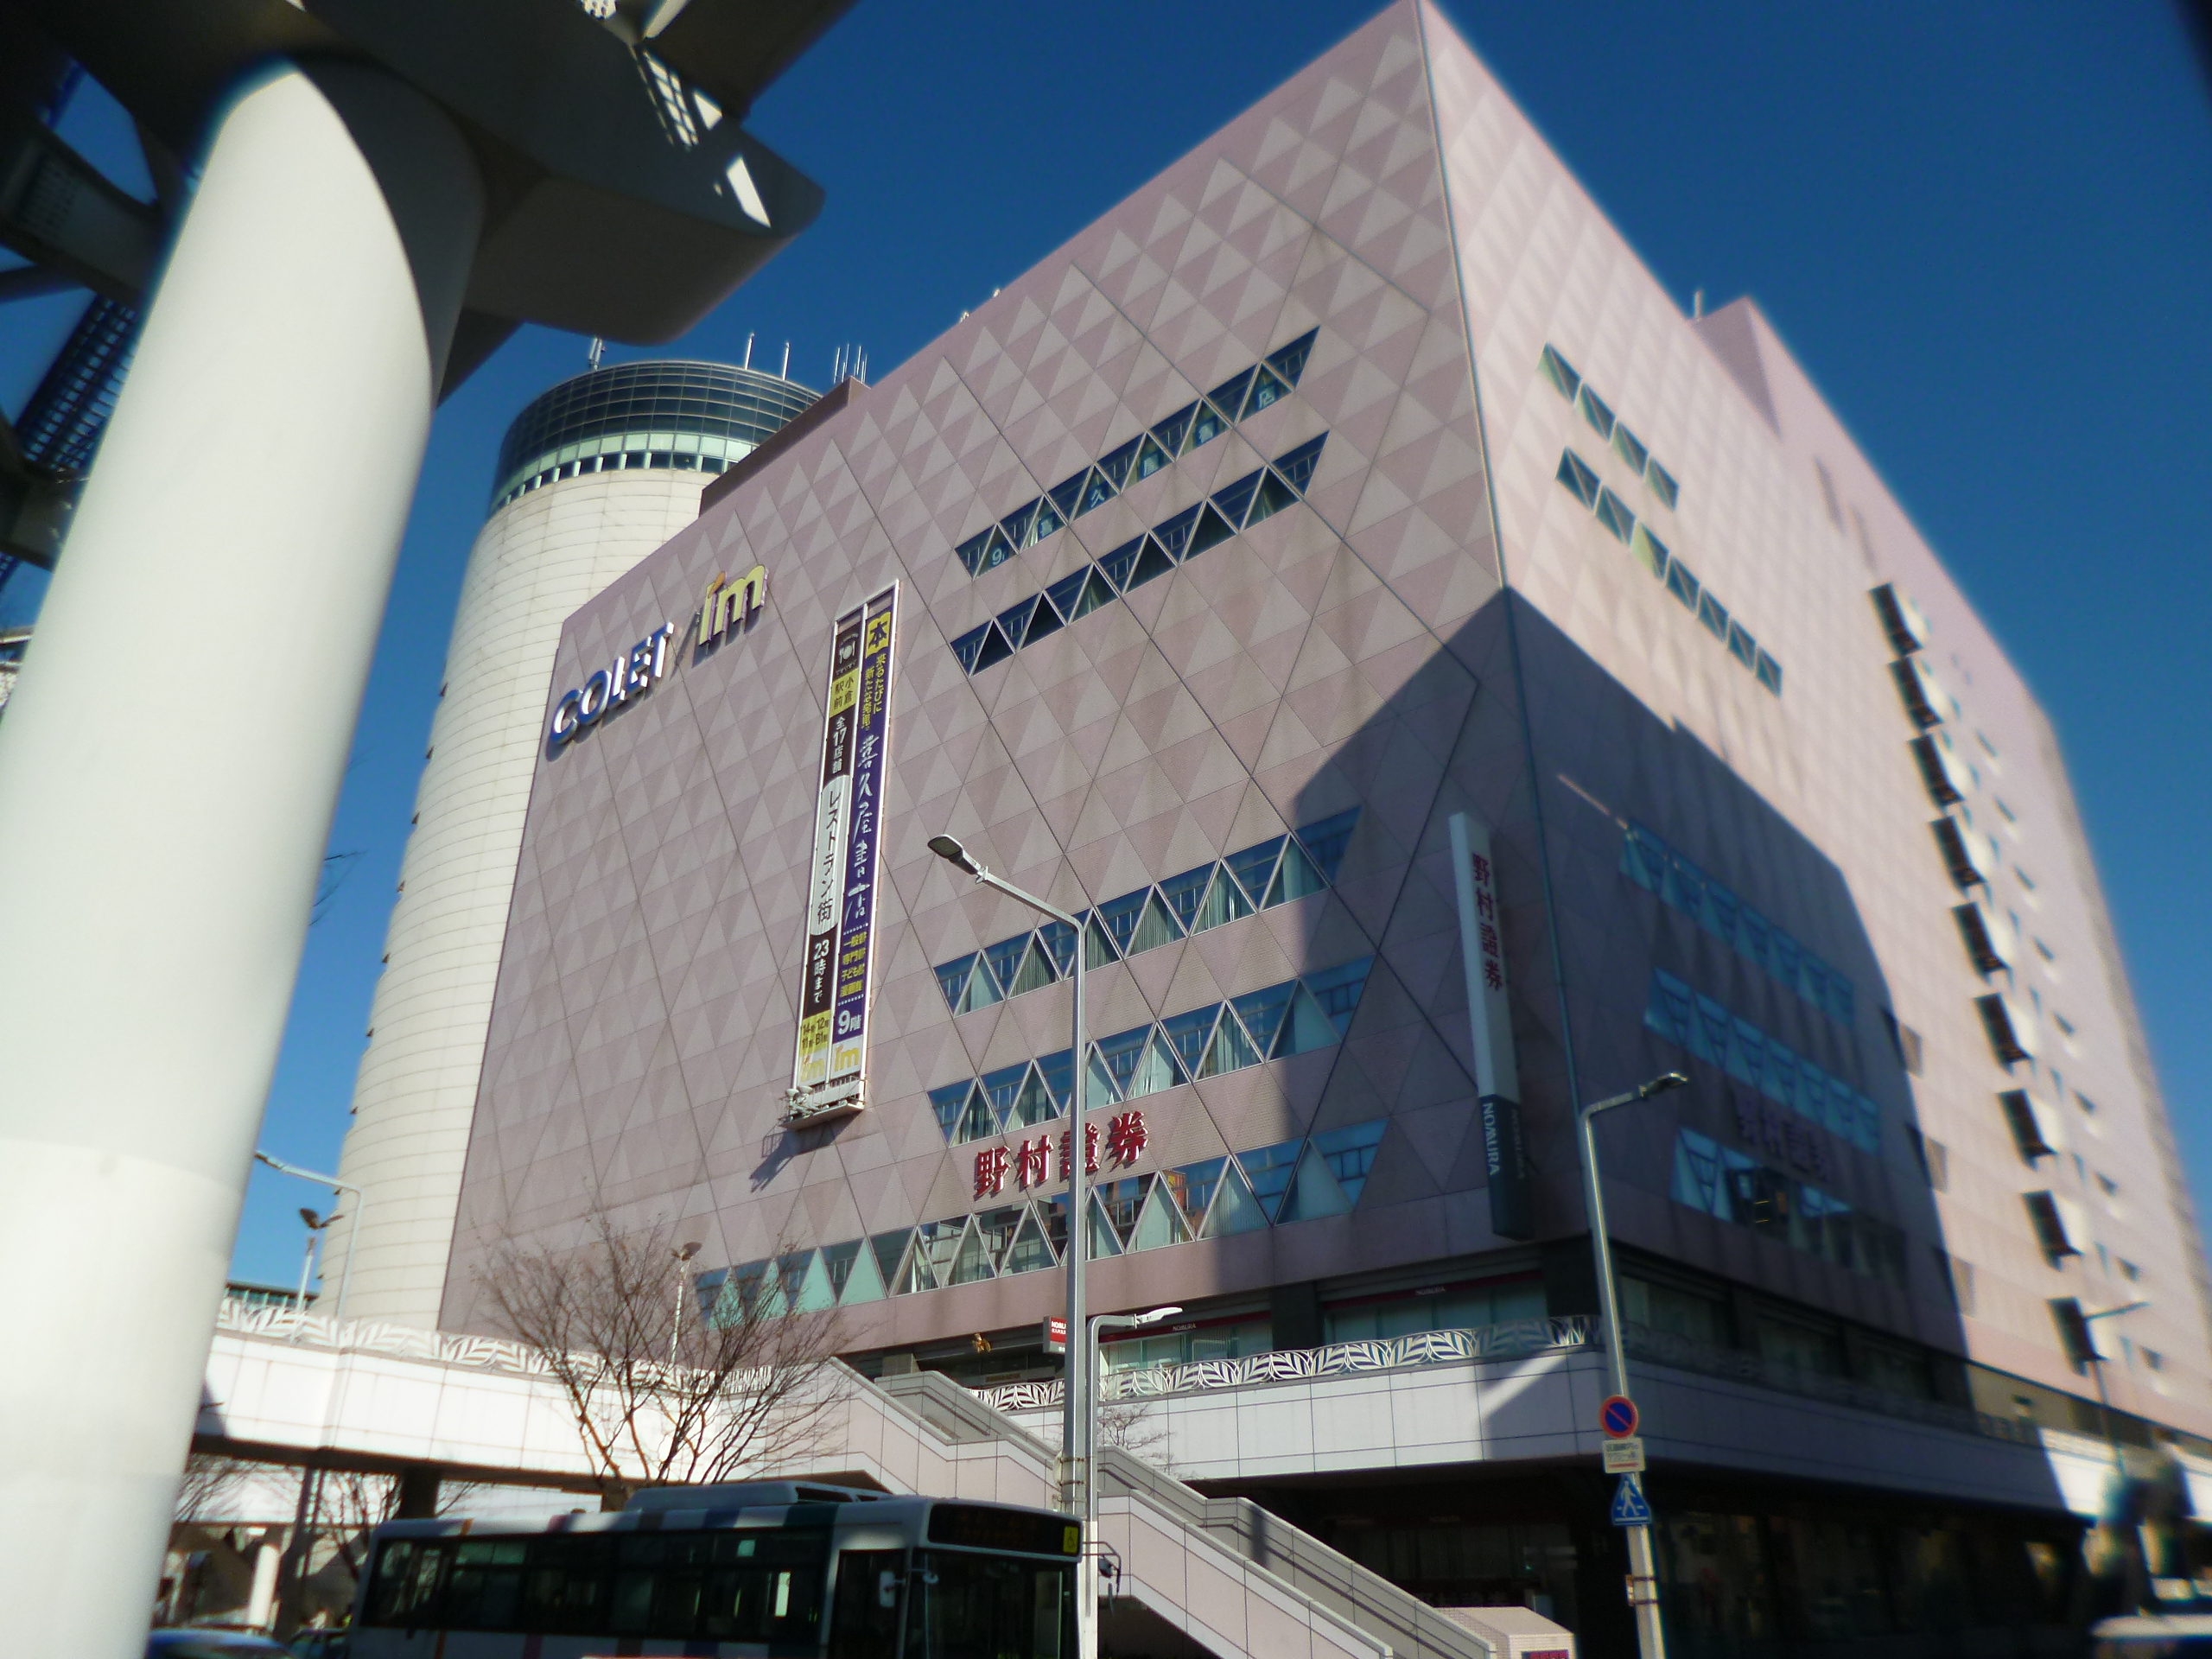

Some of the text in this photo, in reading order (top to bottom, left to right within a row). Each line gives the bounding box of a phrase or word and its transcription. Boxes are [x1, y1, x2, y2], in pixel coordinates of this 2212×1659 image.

[868, 620, 889, 650] 本
[550, 622, 674, 744] COLET
[873, 653, 887, 715] 来るたびに
[832, 716, 848, 774] 全17店舗
[817, 790, 842, 924] レストラン街
[813, 938, 830, 1003] 23時まで
[838, 1009, 862, 1035] 9階
[1482, 1102, 1501, 1177] NOMURA
[1173, 1323, 1197, 1332] NOMURA
